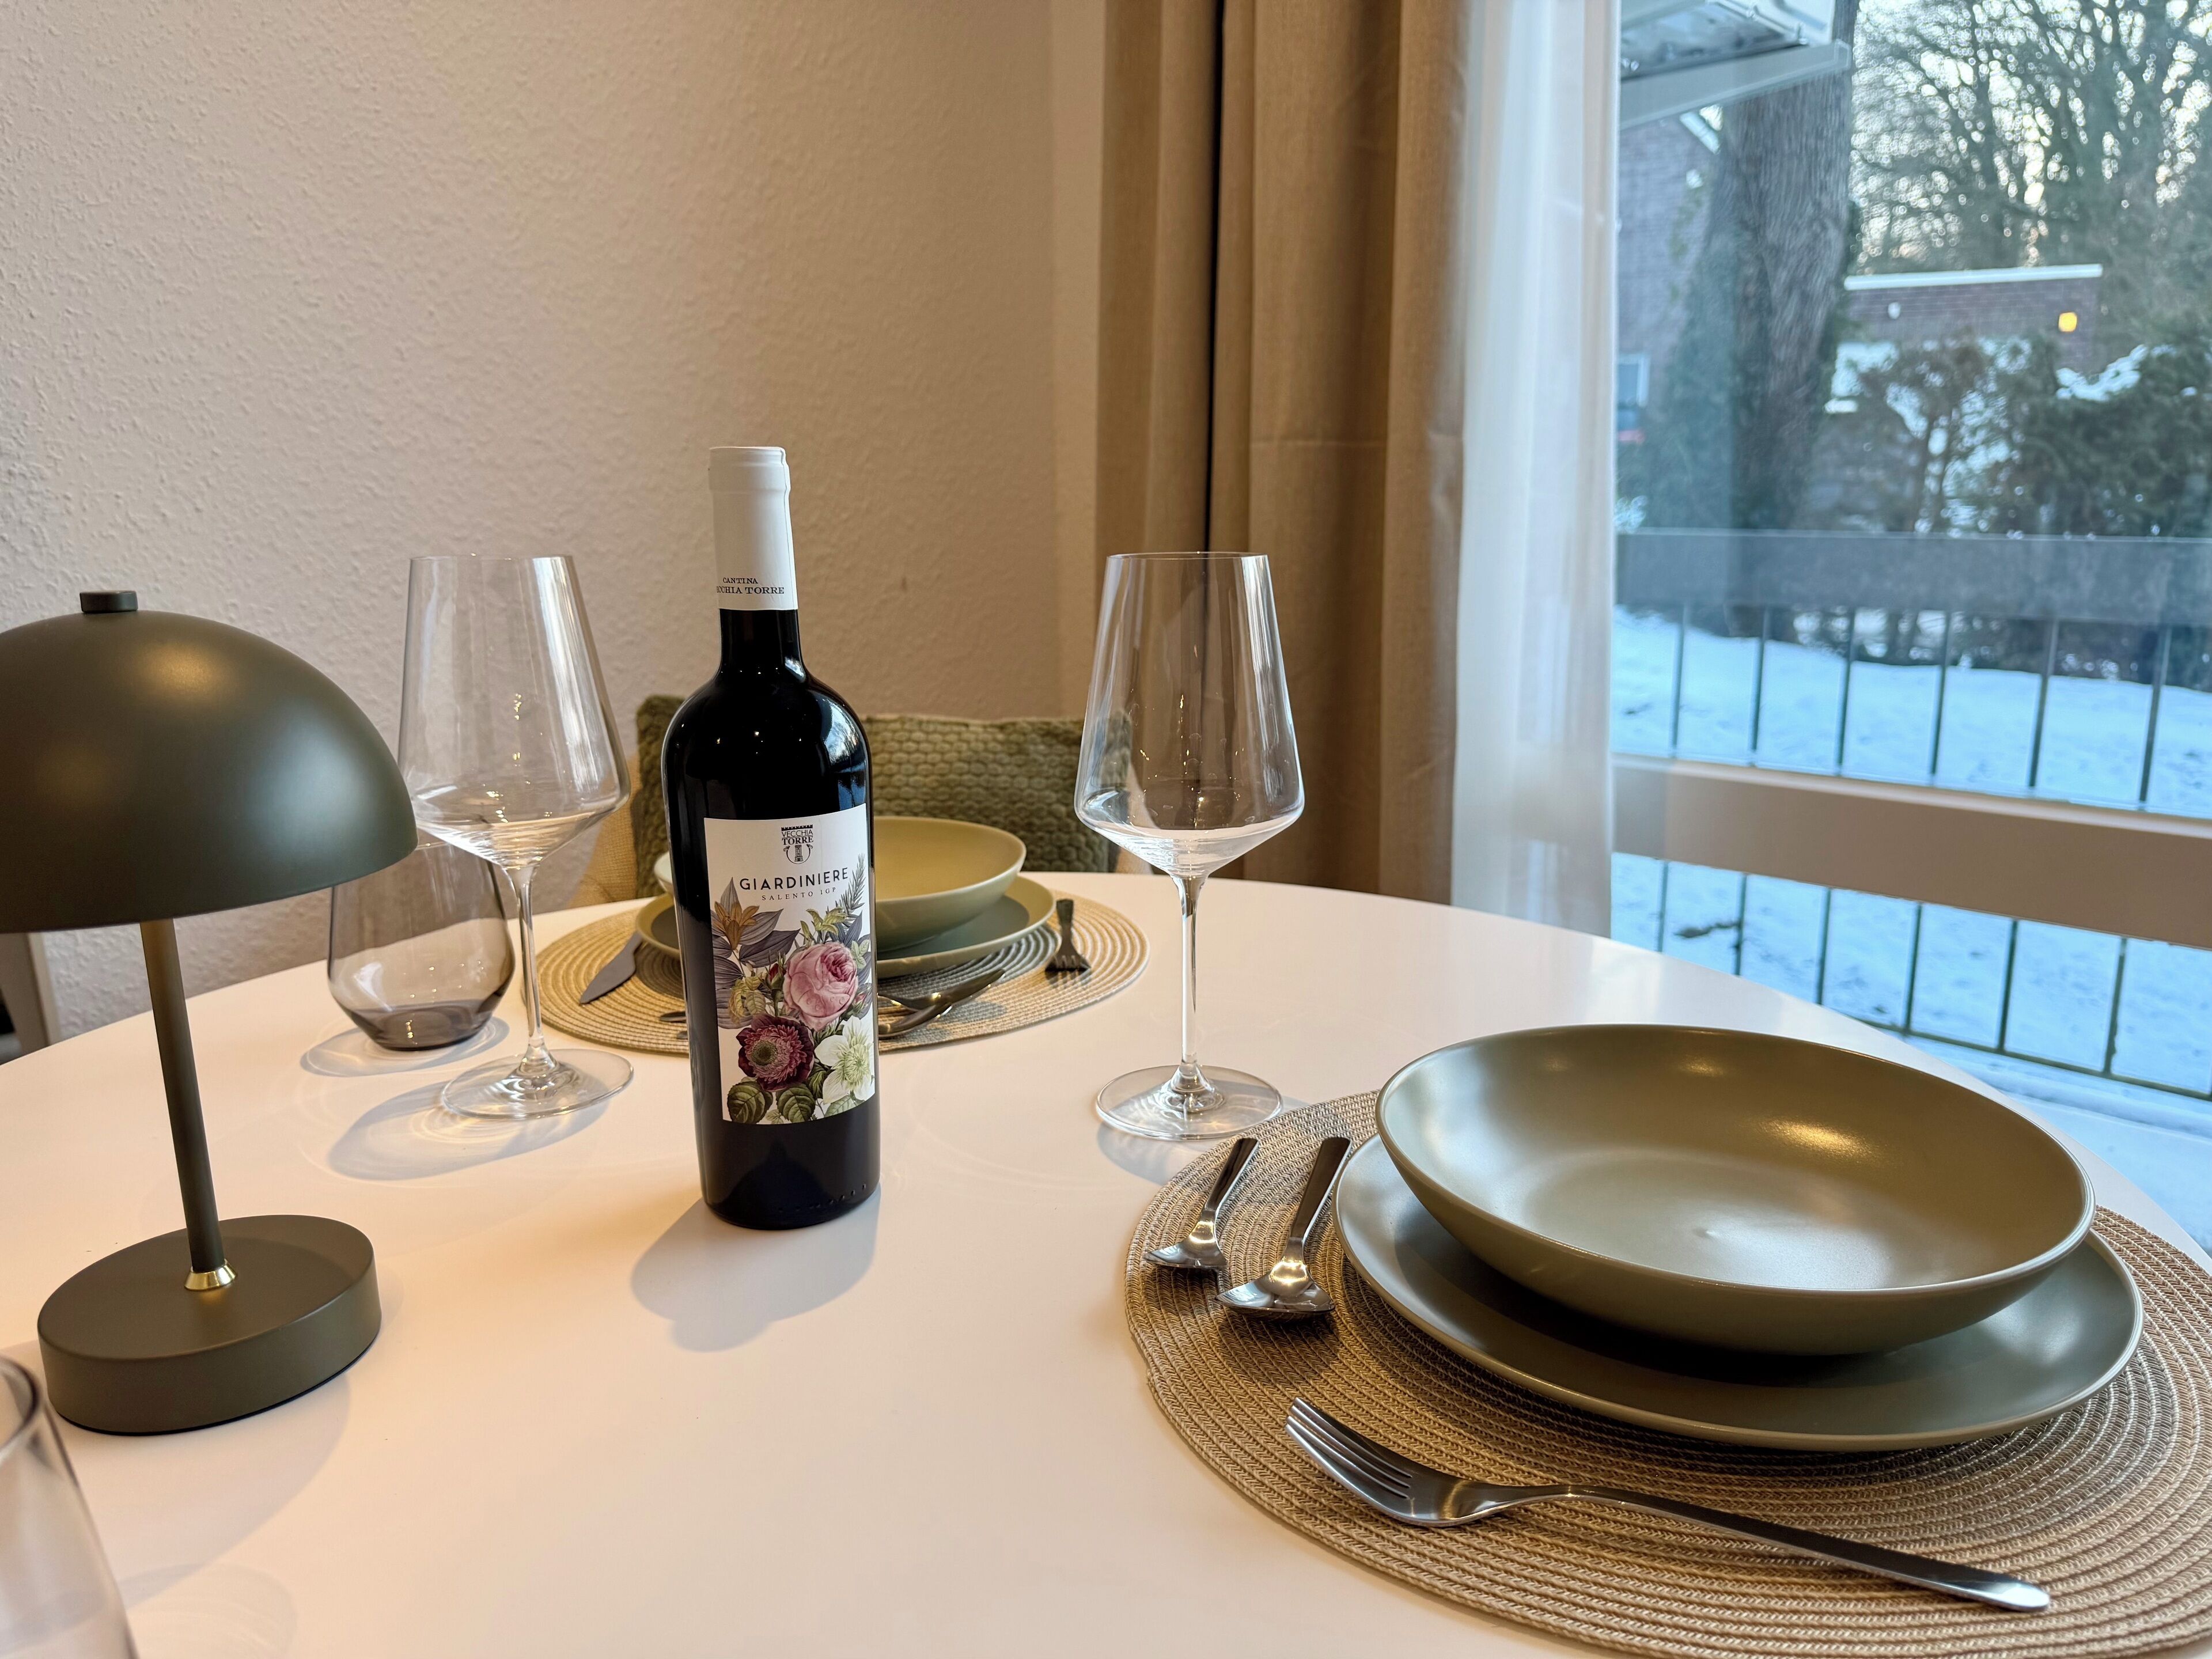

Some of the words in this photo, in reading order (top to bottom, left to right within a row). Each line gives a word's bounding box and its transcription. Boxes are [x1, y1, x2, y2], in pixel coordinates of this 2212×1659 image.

[745, 586, 785, 594] TORRE
[781, 829, 813, 838] VECCHIA
[781, 836, 814, 845] TORRE
[740, 867, 849, 891] GIARDINIERE
[762, 891, 813, 901] SALENTO
[820, 887, 836, 895] IGP
